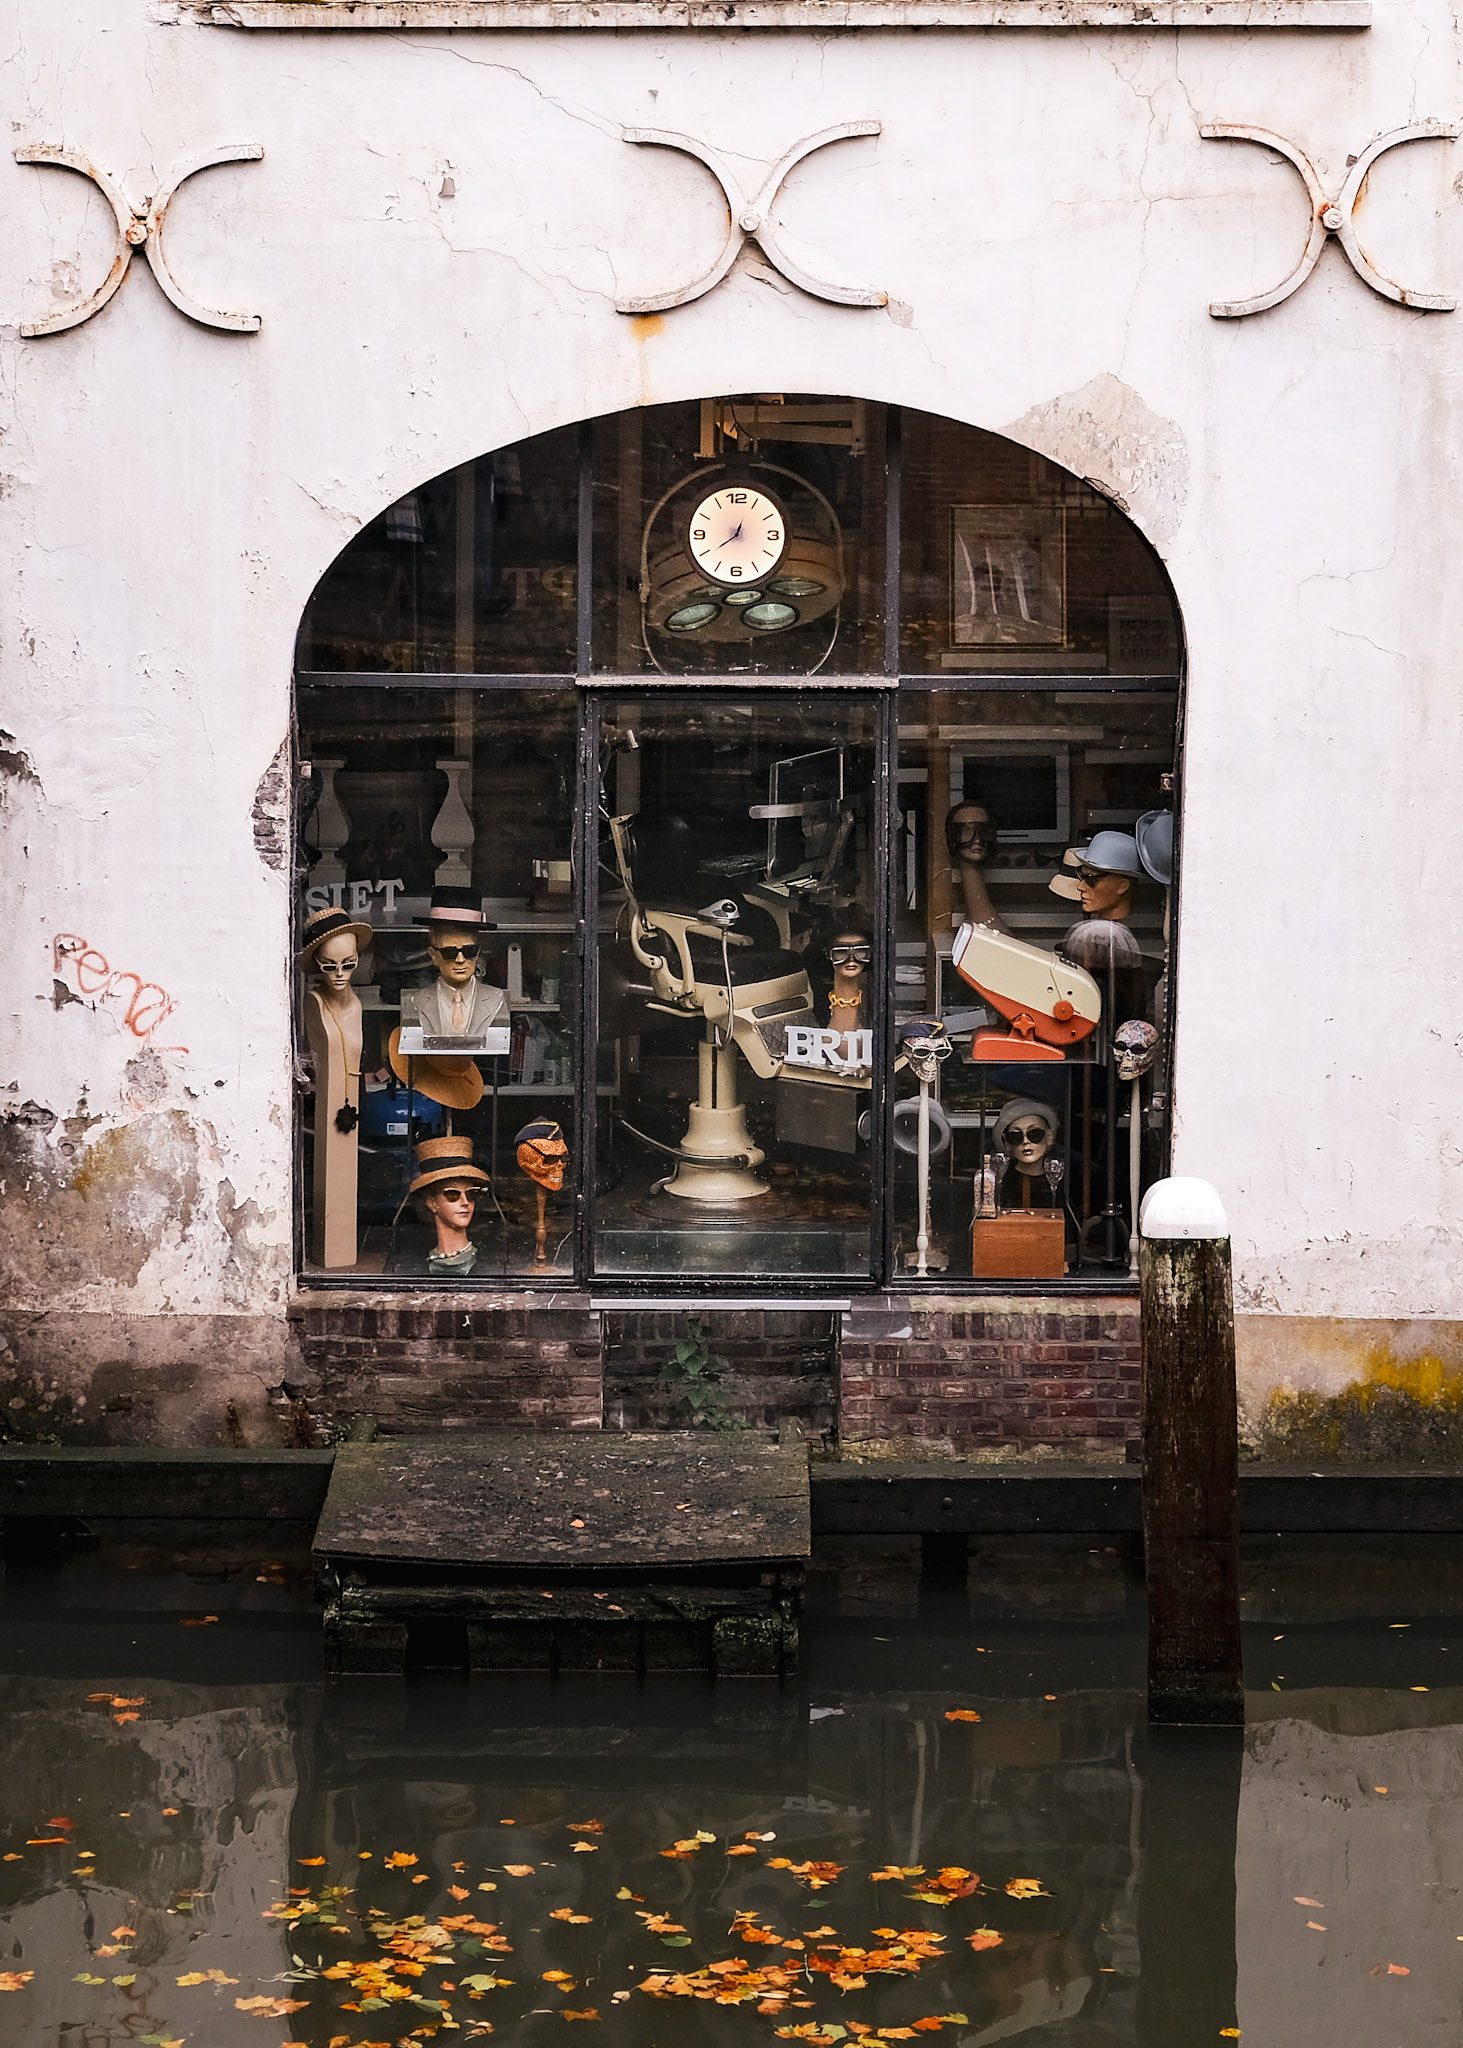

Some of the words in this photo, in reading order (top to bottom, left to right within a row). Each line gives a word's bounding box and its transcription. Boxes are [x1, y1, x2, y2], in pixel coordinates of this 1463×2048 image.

[725, 493, 748, 504] 12
[693, 529, 706, 540] 9
[767, 530, 780, 541] 3
[730, 566, 743, 577] 6
[305, 878, 405, 917] SIET
